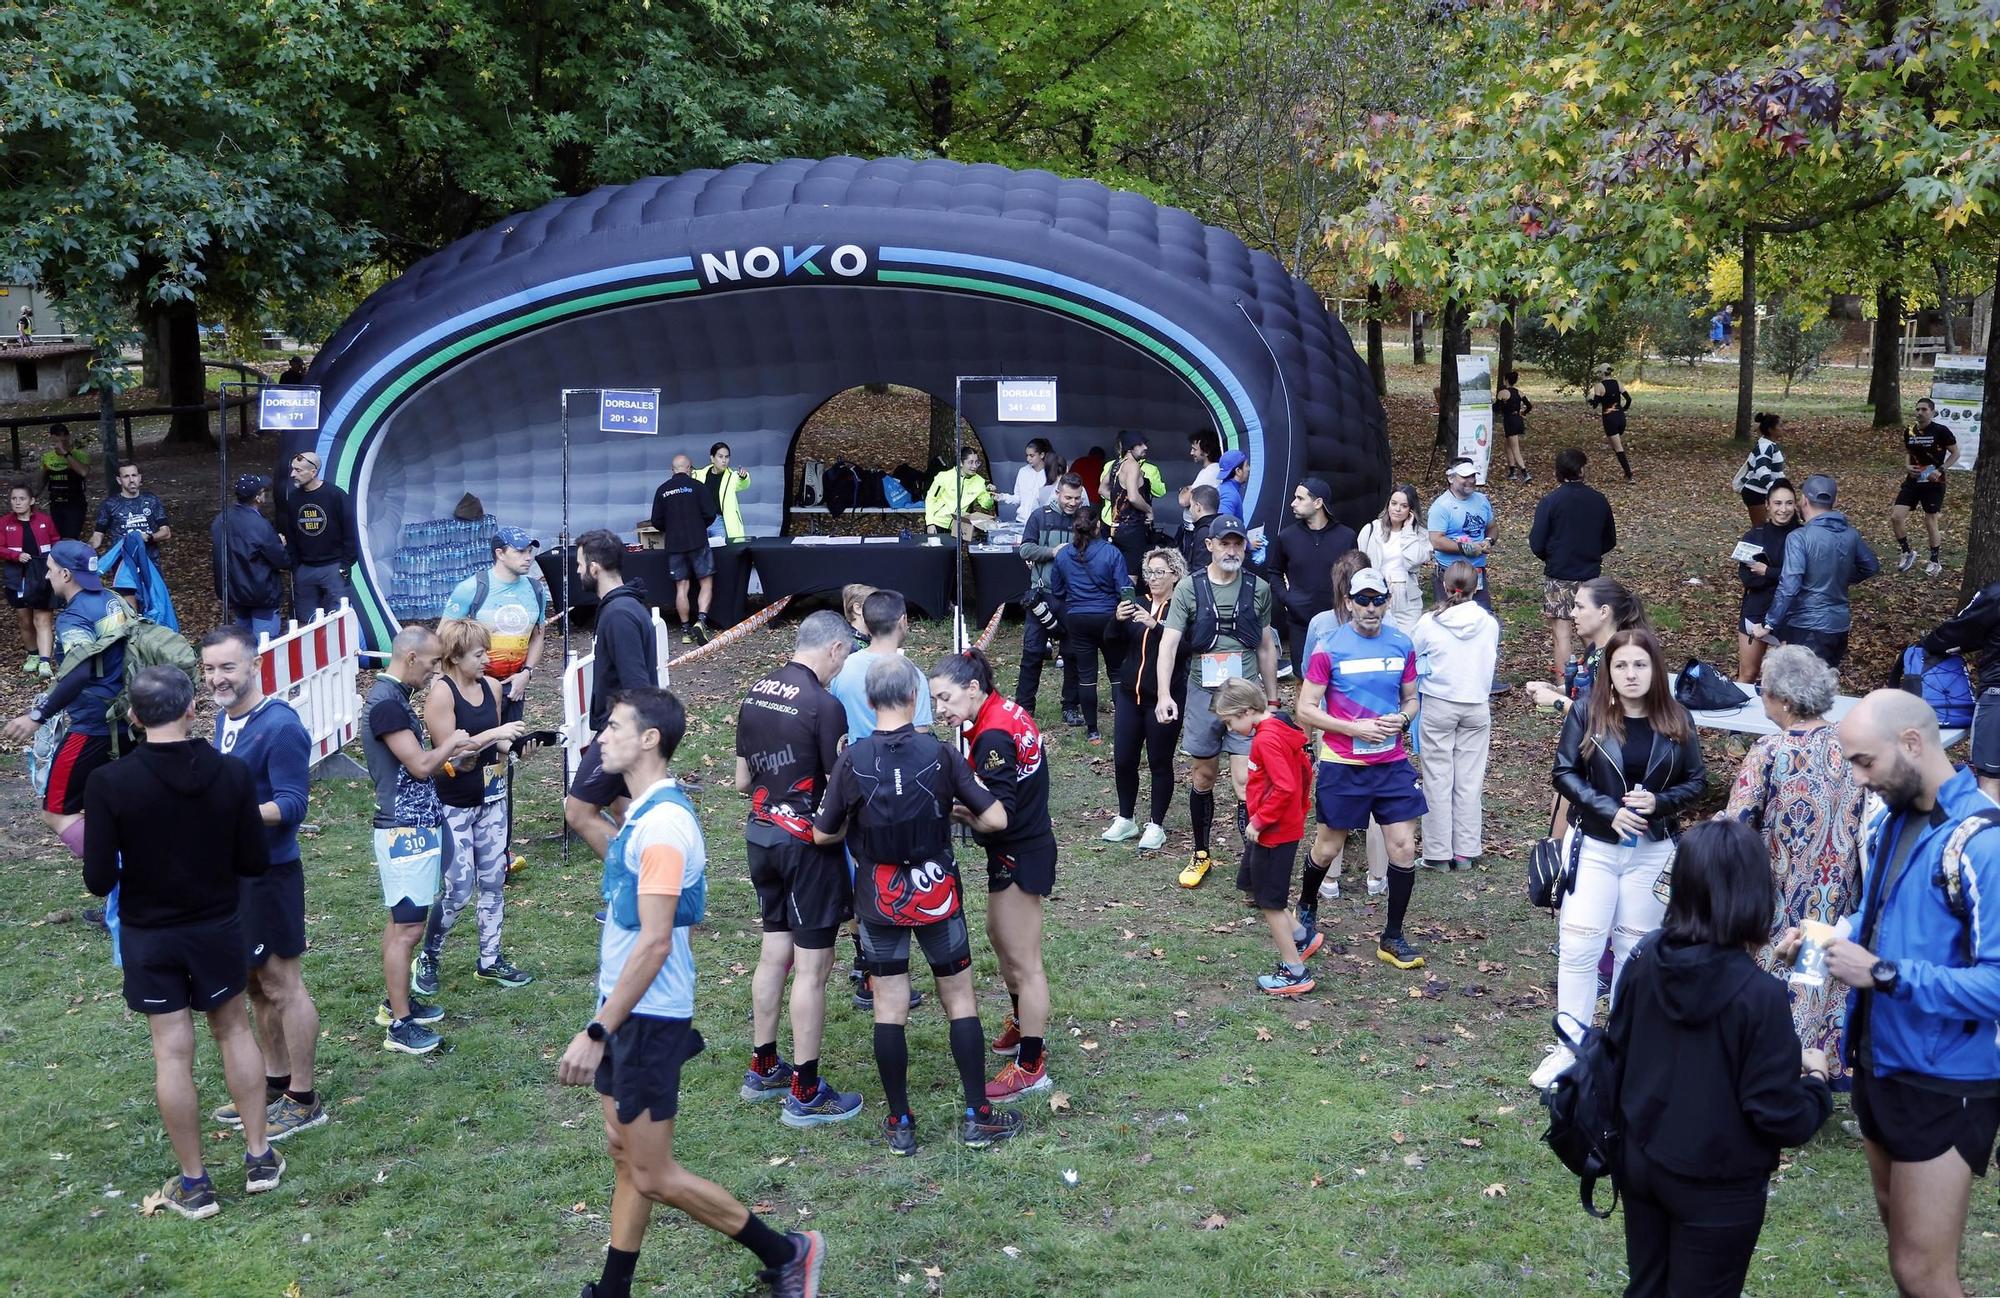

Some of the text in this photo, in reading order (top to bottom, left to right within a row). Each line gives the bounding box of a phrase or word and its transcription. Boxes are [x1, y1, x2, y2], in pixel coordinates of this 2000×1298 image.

[701, 244, 868, 285] NOKO
[1002, 389, 1051, 398] DORSALES
[265, 398, 316, 407] DORSALES
[605, 399, 655, 410] DORSALES
[1008, 403, 1023, 412] 341
[289, 412, 304, 421] 171
[610, 414, 625, 423] 201
[632, 415, 648, 424] 340
[303, 510, 317, 518] TEAM
[752, 679, 800, 700] CARMA
[755, 699, 799, 716] MARISQUEIRO
[894, 768, 903, 796] KIPRUN
[404, 836, 426, 851] 310
